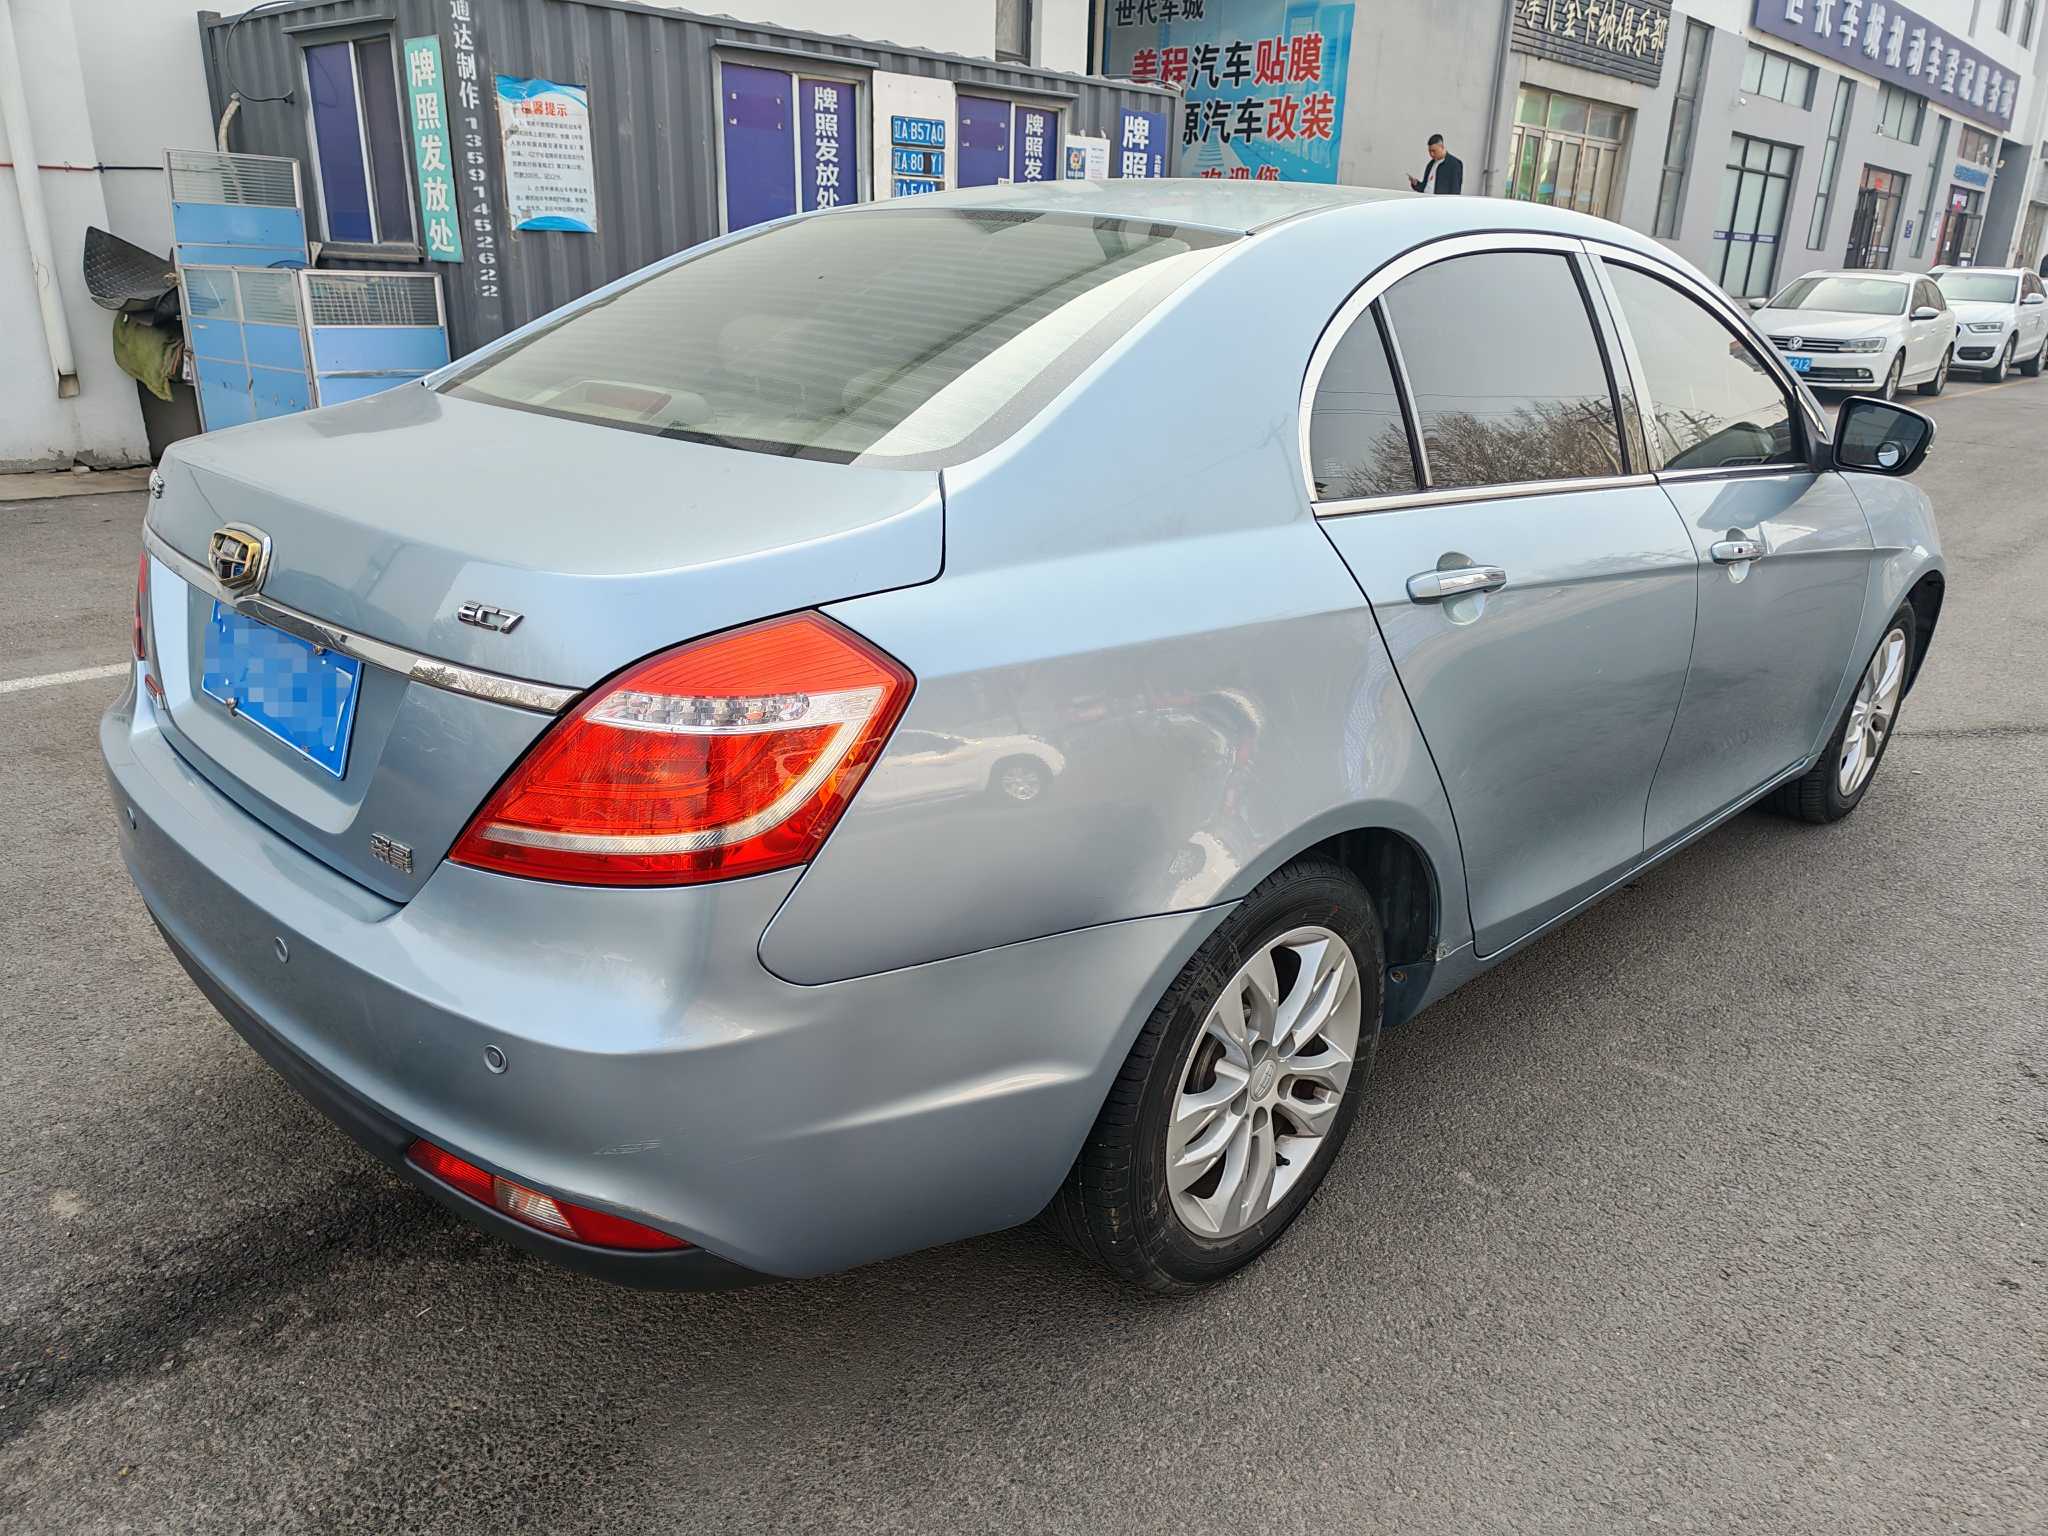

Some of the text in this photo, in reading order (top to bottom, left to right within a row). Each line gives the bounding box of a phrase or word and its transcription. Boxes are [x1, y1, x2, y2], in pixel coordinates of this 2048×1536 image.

[410, 47, 455, 253] 牌照发放处
[814, 86, 840, 210] 牌照发放处
[1024, 113, 1044, 184] 牌照发
[457, 600, 524, 635] EC7
